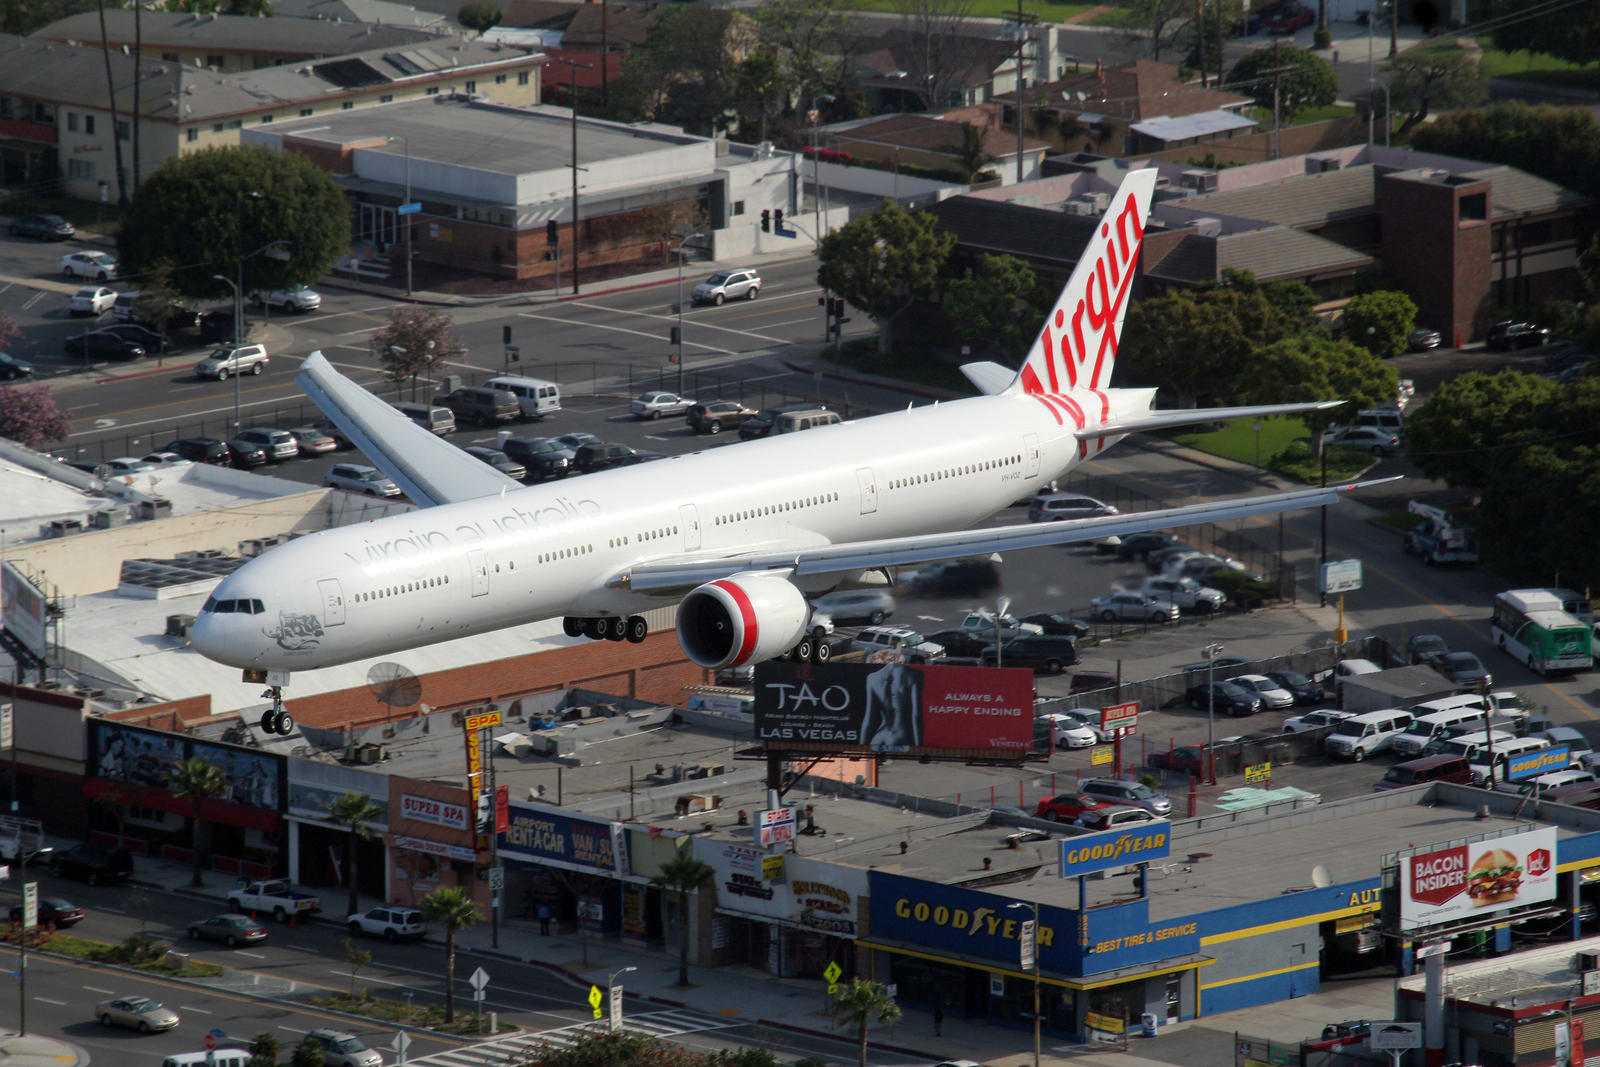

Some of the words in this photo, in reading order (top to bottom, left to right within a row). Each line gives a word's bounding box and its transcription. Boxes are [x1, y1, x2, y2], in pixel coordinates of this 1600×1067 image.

[765, 682, 850, 711] TAO
[945, 692, 991, 702] ALWAYS
[928, 704, 970, 714] HAPPY
[974, 707, 1022, 716] ENDING
[468, 714, 500, 729] SPA
[760, 728, 794, 738] LAS
[799, 729, 857, 740] VEGAS
[1511, 752, 1568, 773] GOODYEAR
[404, 798, 440, 816] SUPER
[443, 805, 464, 821] SPA
[513, 816, 556, 833] AIRPORT
[1067, 833, 1167, 864] GOODYEAR
[1416, 853, 1464, 879] BACON
[1415, 872, 1464, 894] INSIDER
[896, 899, 1054, 947] GOODYER
[1096, 938, 1122, 954] BEST
[1124, 933, 1146, 948] TIRE
[1146, 932, 1153, 942] &
[1155, 922, 1197, 941] SERVICE
